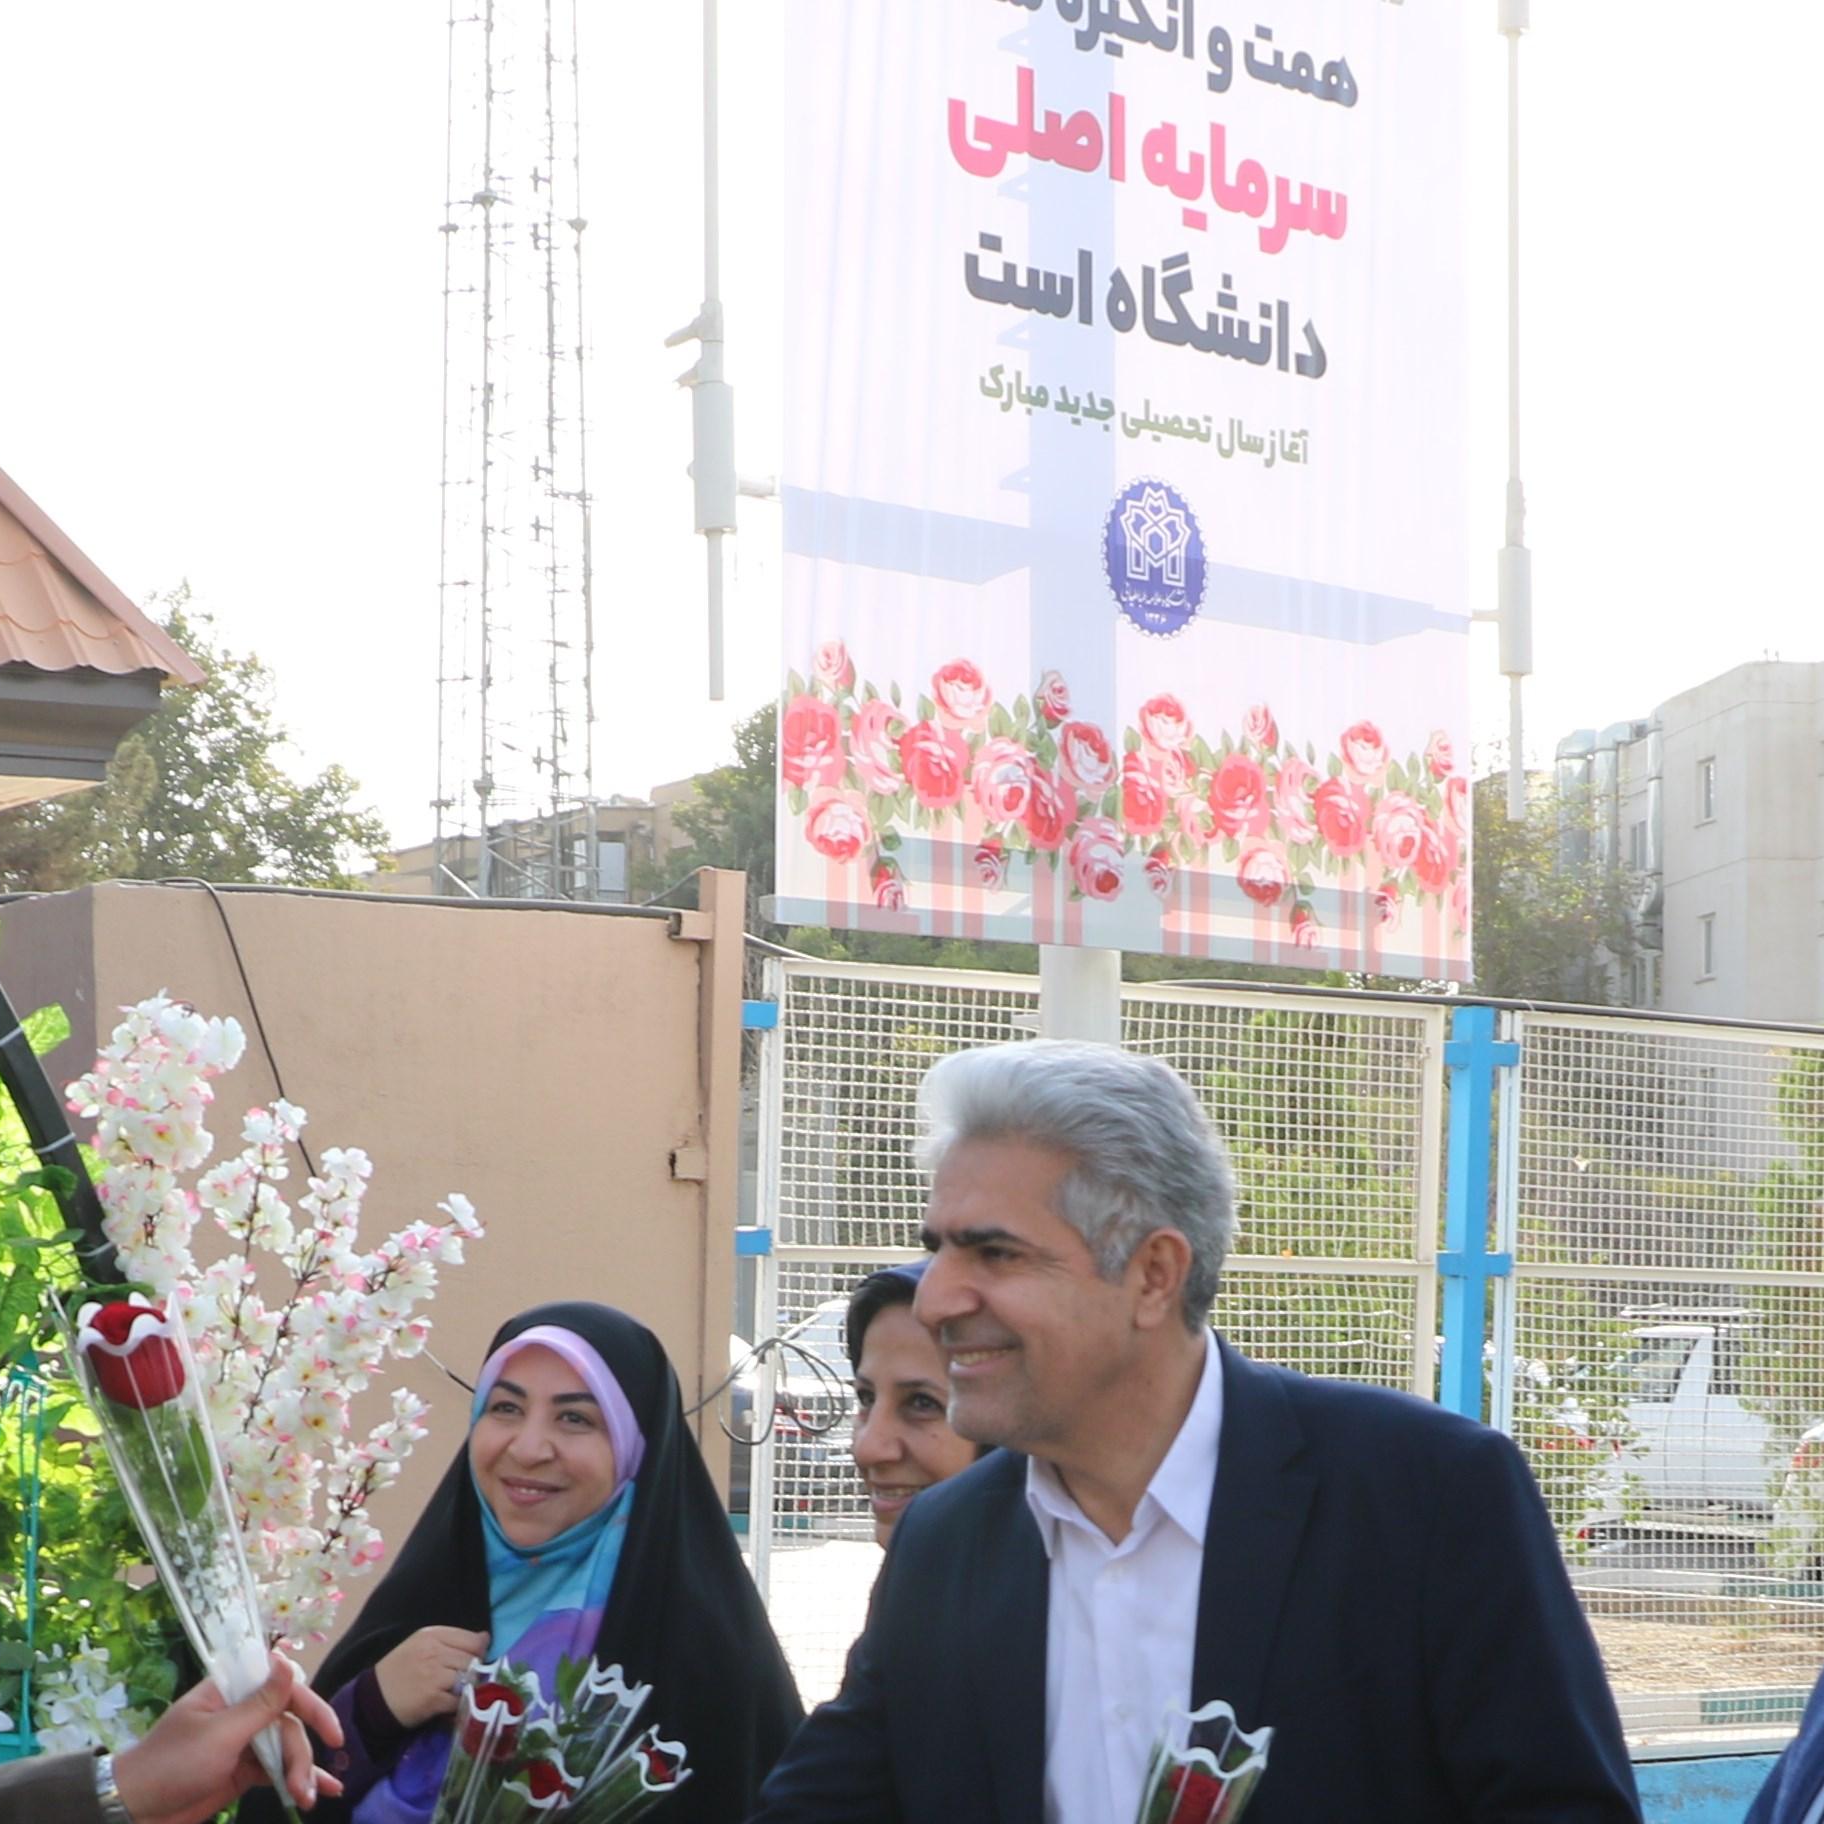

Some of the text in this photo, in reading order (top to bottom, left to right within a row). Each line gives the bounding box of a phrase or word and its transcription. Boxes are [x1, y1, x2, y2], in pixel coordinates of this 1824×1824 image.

[1207, 22, 1233, 93] و
[1245, 24, 1359, 107] همت
[948, 66, 1348, 254] سرمایه اصلی
[963, 231, 1327, 379] دانشگاه است
[979, 363, 1309, 468] آغاز سال تحصیلی جدید مبارک
